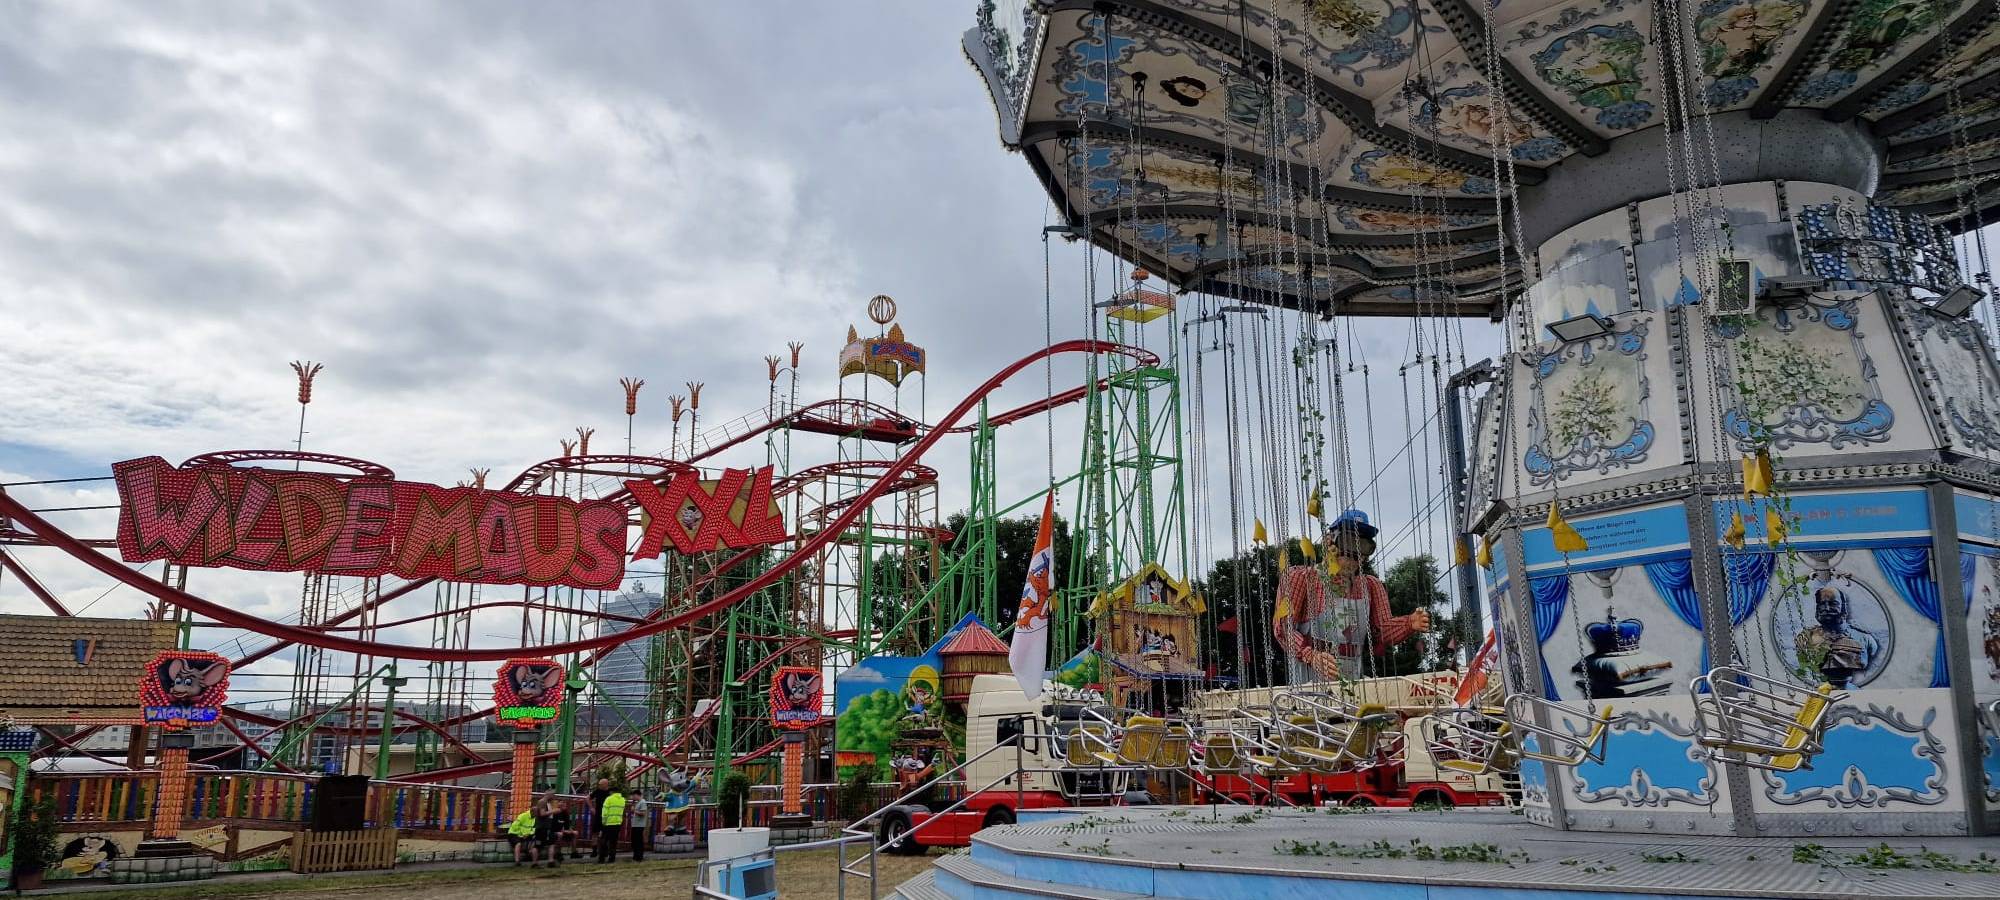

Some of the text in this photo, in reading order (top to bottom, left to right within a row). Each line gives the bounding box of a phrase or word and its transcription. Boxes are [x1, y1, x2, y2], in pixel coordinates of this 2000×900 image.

[124, 462, 787, 586] WILDE MAUS XXL
